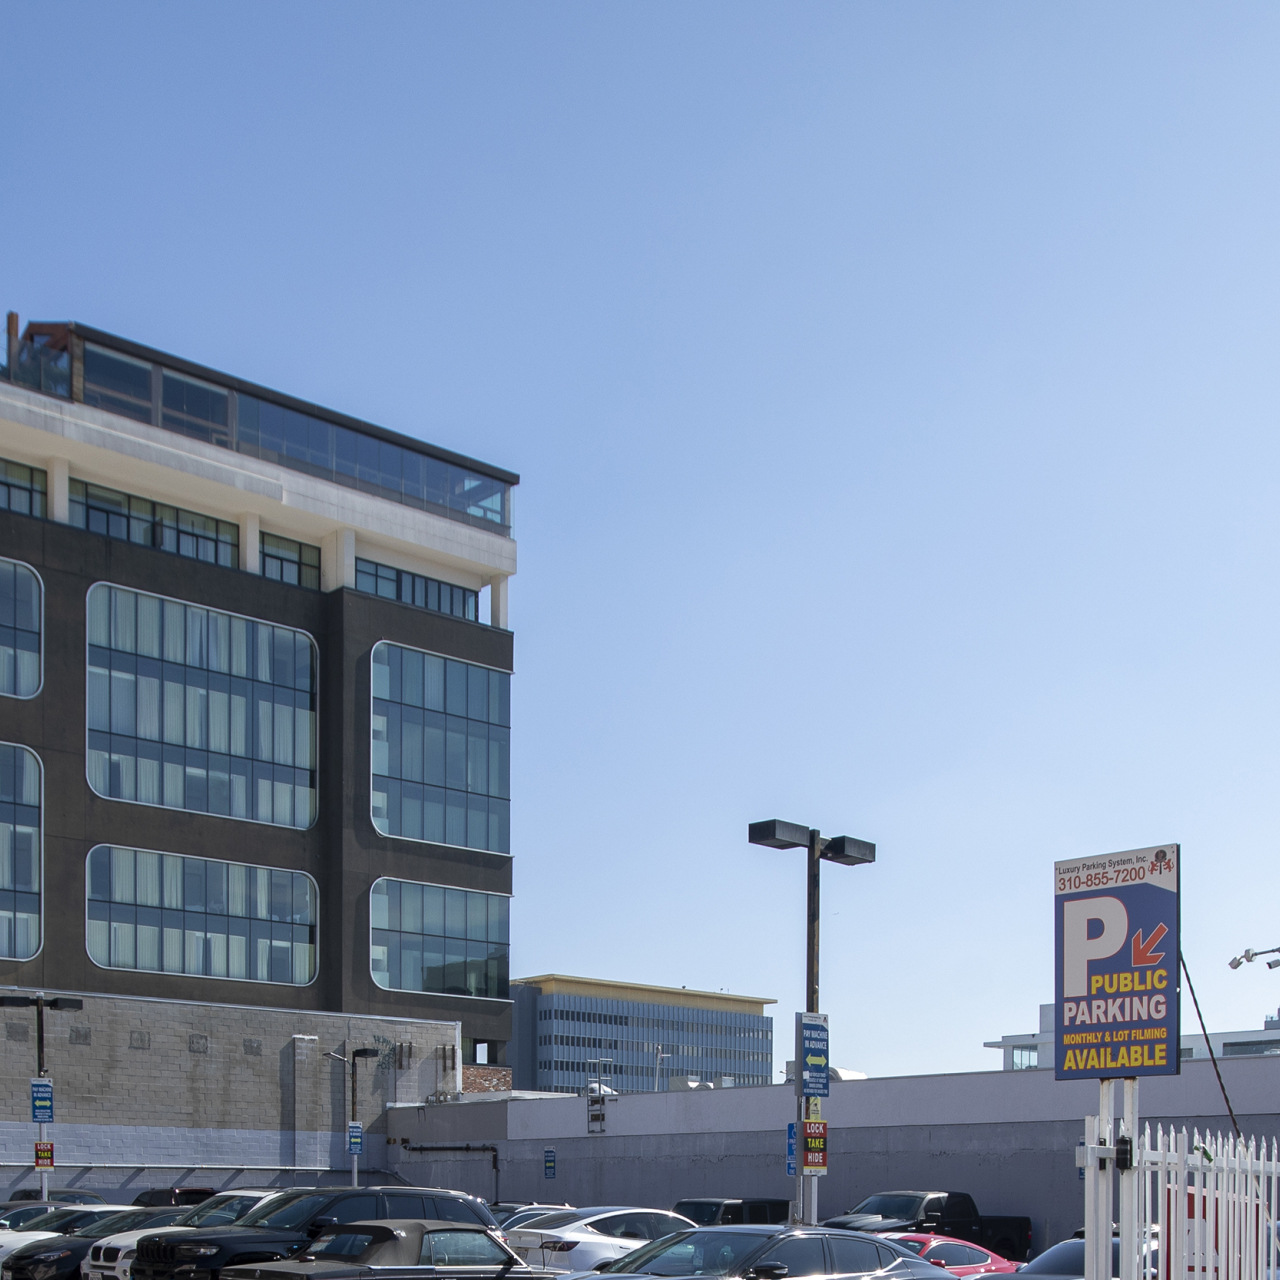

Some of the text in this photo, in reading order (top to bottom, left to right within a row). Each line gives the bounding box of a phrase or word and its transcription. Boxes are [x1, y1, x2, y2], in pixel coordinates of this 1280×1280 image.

[1059, 864, 1080, 876] Luxury
[1082, 860, 1106, 872] Parking
[1108, 858, 1134, 870] System,
[1059, 866, 1145, 891] 310-855-7200
[1063, 896, 1129, 998] P
[1091, 969, 1168, 995] PUBLIC
[1063, 994, 1166, 1026] PARKING
[1063, 1027, 1167, 1045] MONTHLY & LOT FILMING
[1063, 1044, 1167, 1070] AVAILABLE
[807, 1123, 823, 1133] LOCK
[808, 1138, 824, 1148] TAKE
[808, 1153, 823, 1162] HIDE
